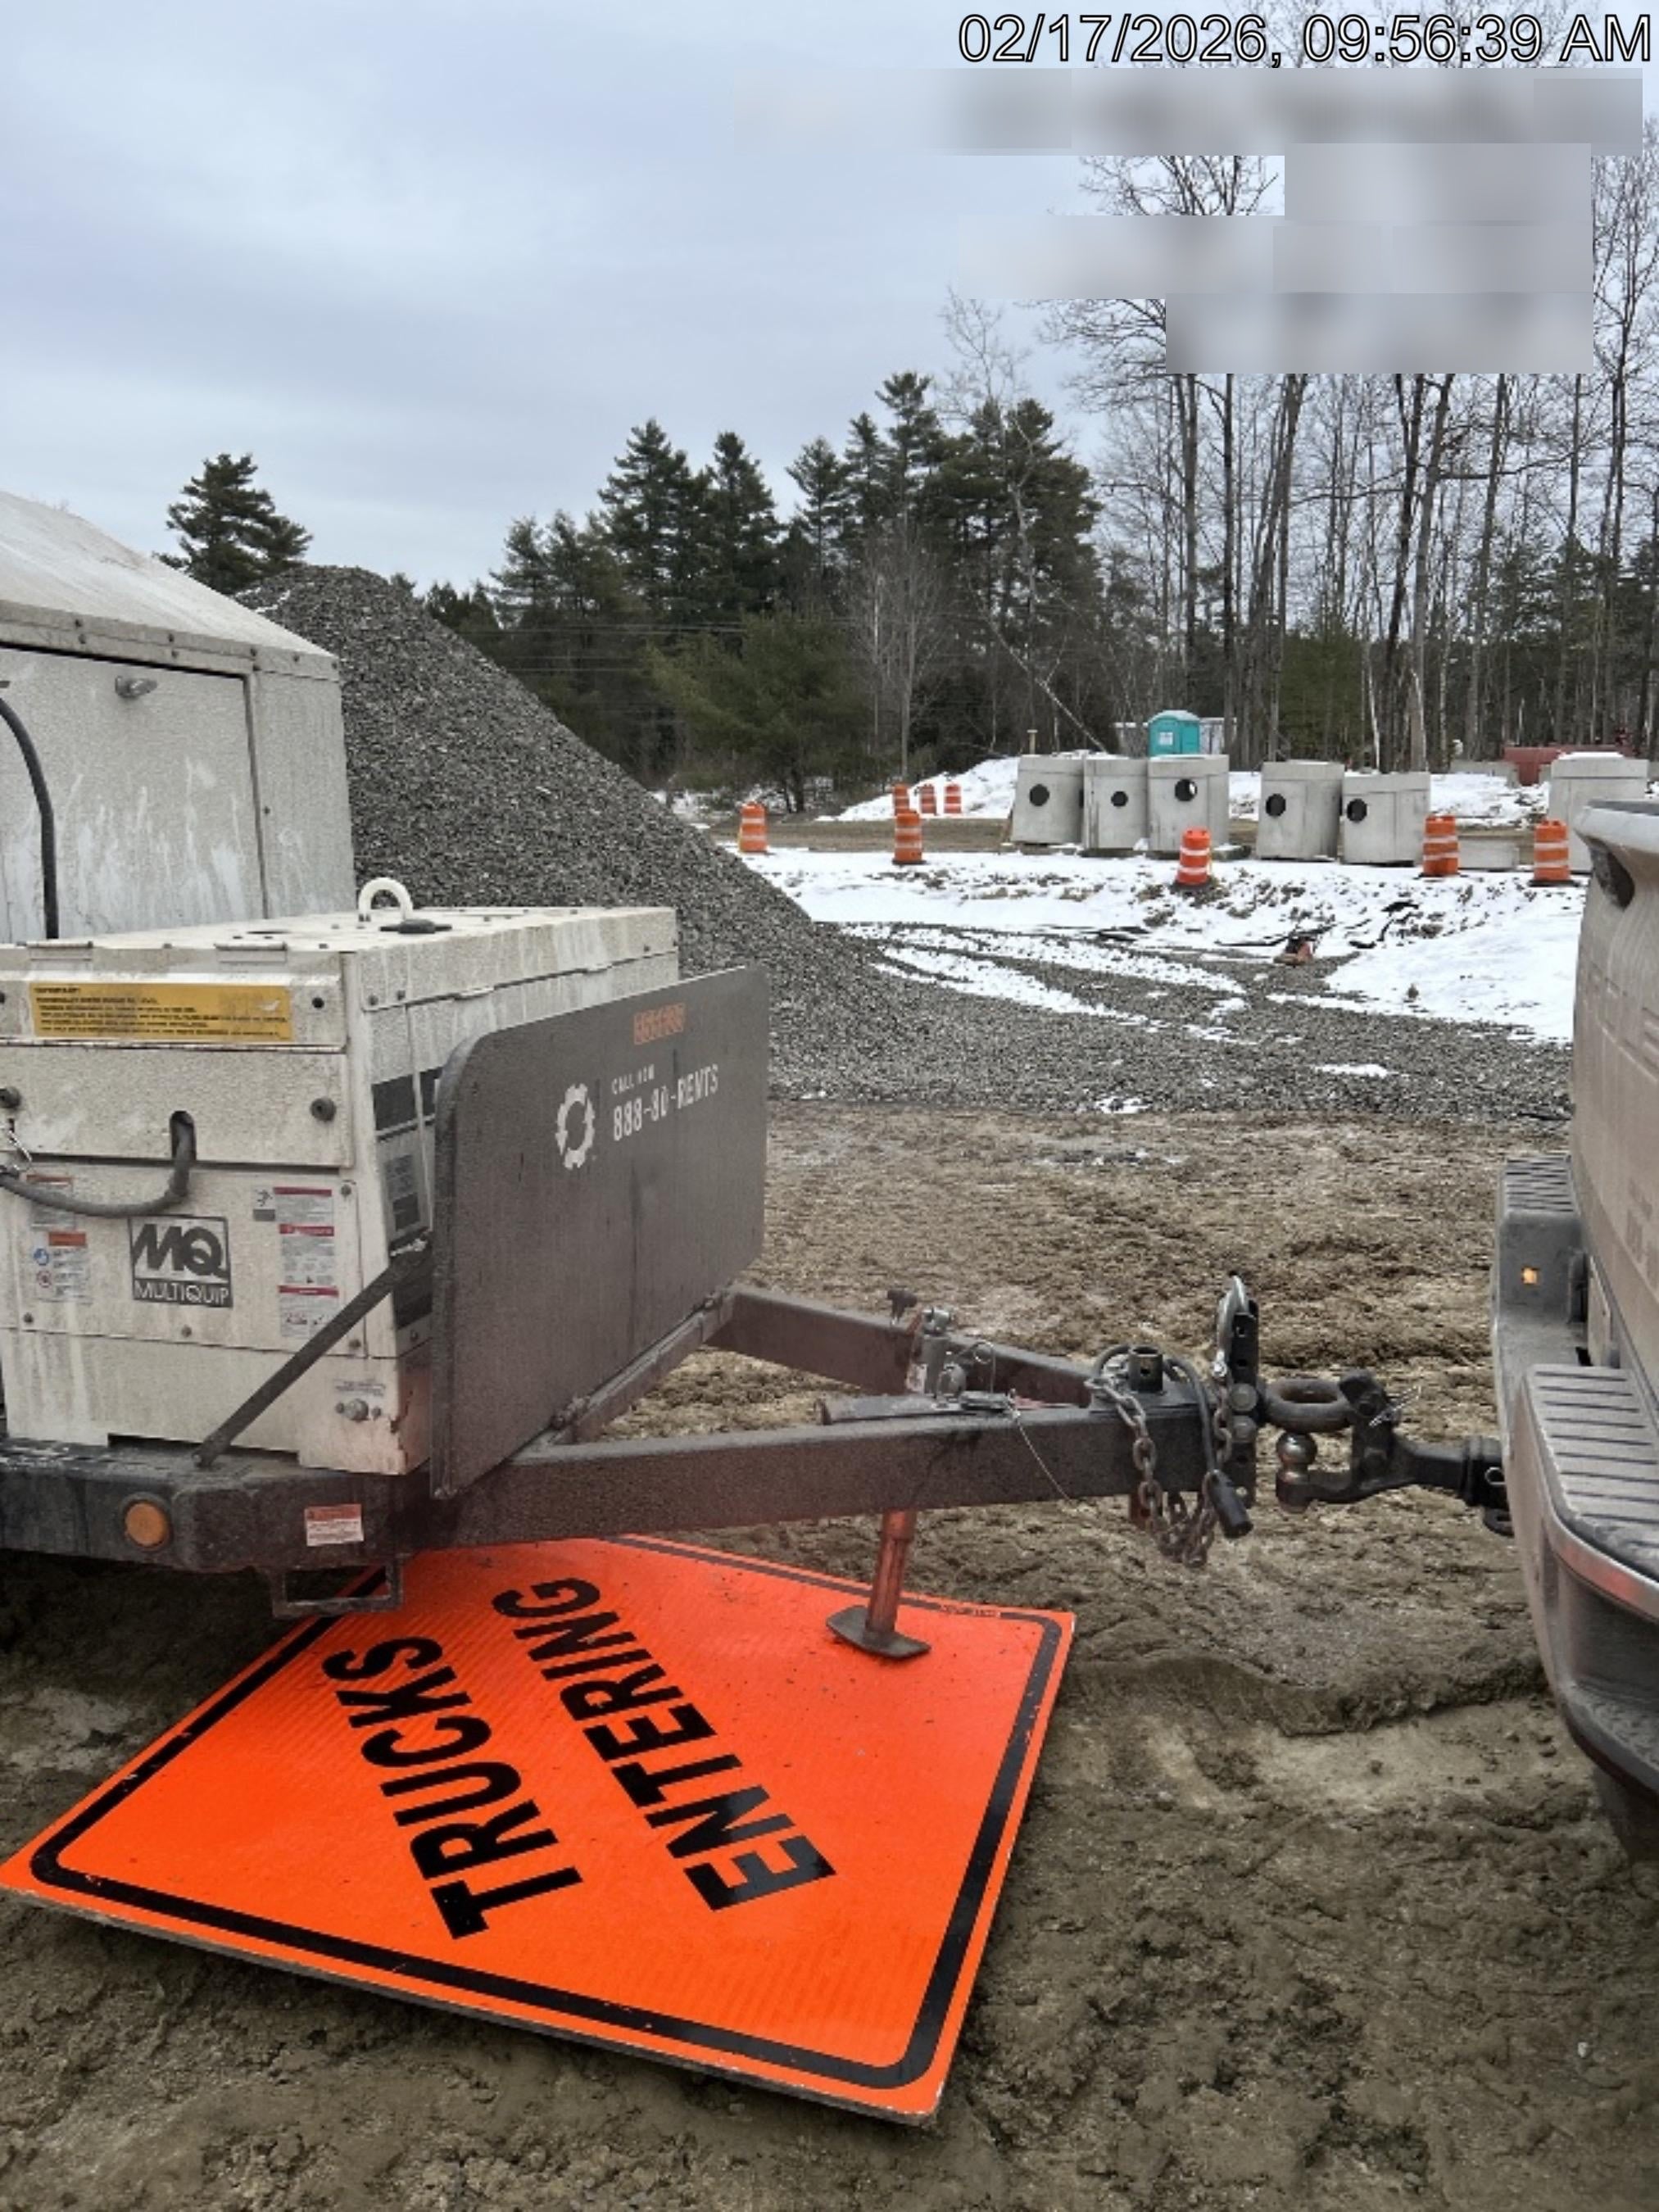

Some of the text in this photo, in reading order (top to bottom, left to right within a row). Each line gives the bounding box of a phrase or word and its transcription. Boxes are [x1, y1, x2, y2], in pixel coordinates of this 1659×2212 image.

[612, 1074, 635, 1095] CALL
[131, 1223, 229, 1278] MQ
[134, 1280, 229, 1305] MULTIQUIP
[493, 1577, 836, 1912] ENTERING
[321, 1635, 583, 1940] TRUCKS
